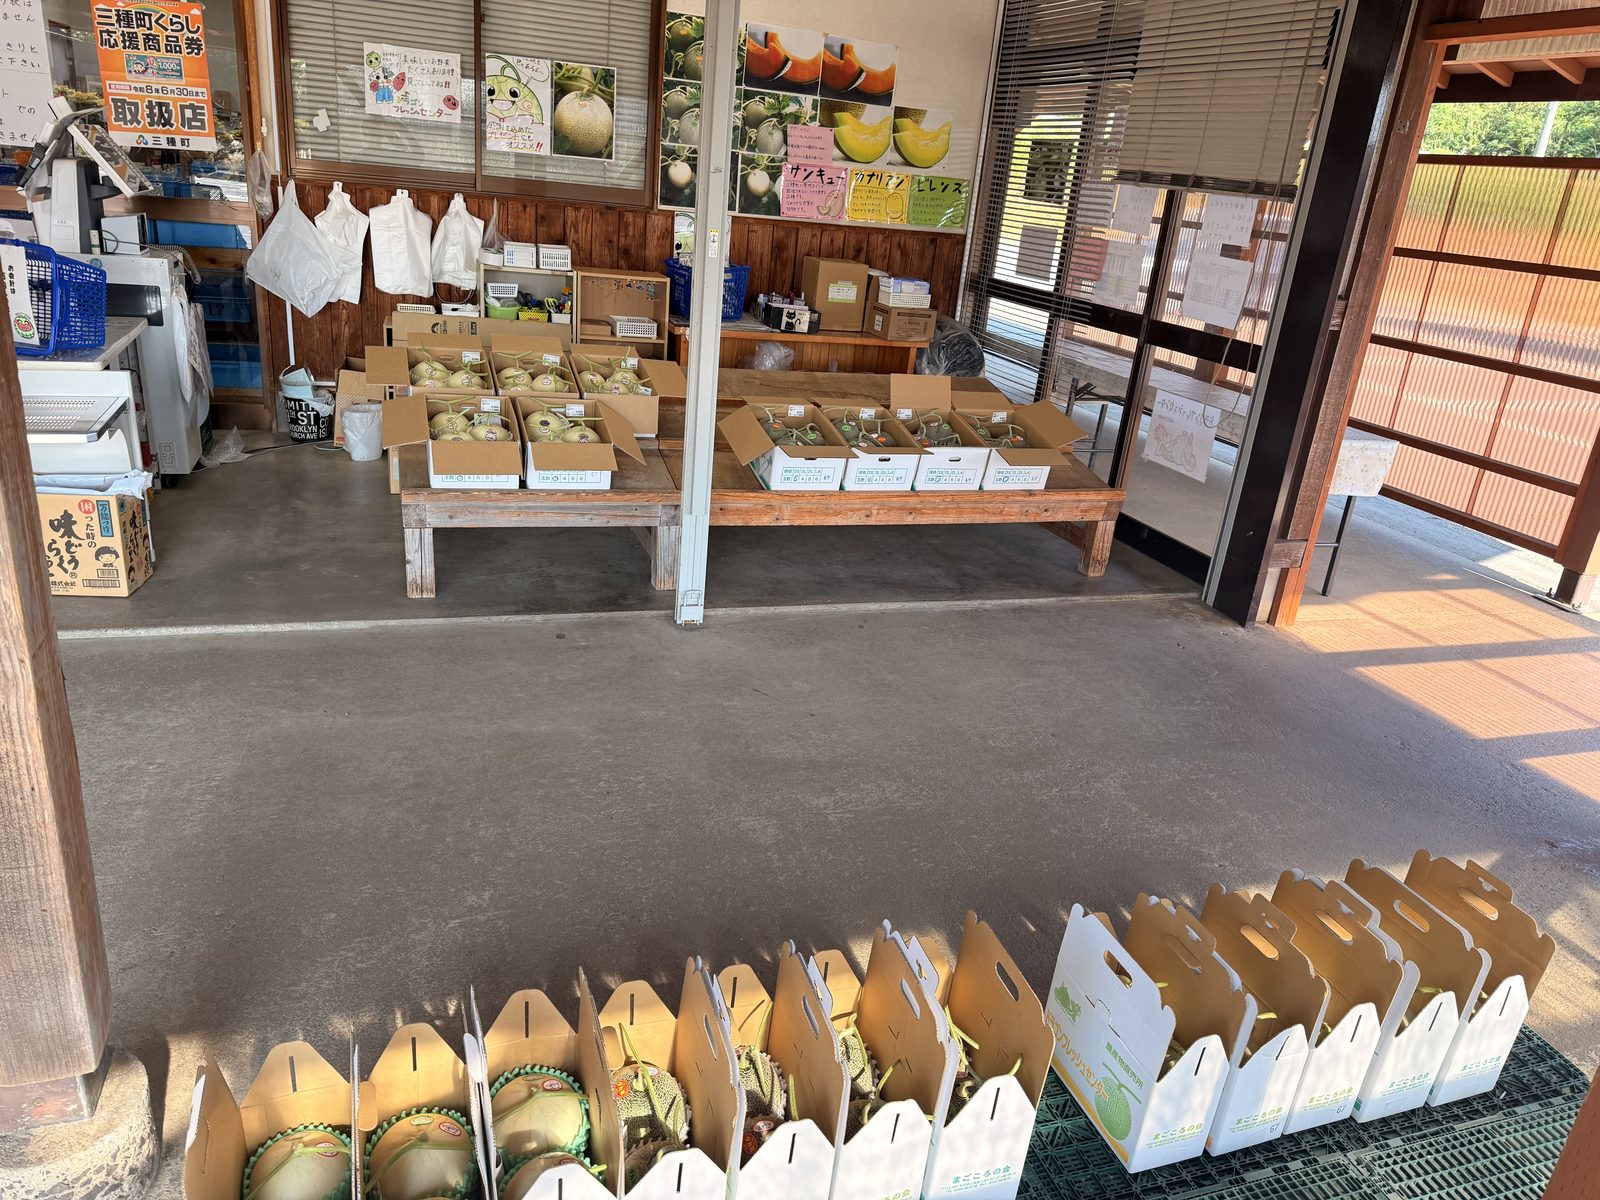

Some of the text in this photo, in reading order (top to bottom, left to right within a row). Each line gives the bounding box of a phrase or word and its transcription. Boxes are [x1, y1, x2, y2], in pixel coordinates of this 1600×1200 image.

[95, 7, 201, 34] 三種町くらし
[98, 29, 203, 56] 応援商品券
[132, 85, 206, 97] 令和8年6月30日まで
[110, 97, 207, 131] 取扱店
[151, 135, 191, 147] 三種町
[788, 165, 846, 185] サンキュー
[917, 178, 963, 194] ビレンス
[297, 411, 317, 426] ST
[1046, 1009, 1110, 1101] ドラゴンフレッシュセンター
[1460, 1055, 1502, 1072] まごころの会
[1105, 1041, 1145, 1090] 農産物直売所
[1388, 1071, 1430, 1089] まごころの会
[1308, 1086, 1354, 1104] まごころの会
[1234, 1106, 1284, 1126] まごころの会
[1152, 1122, 1204, 1141] まごころの会
[952, 1165, 1012, 1184] まごころの会
